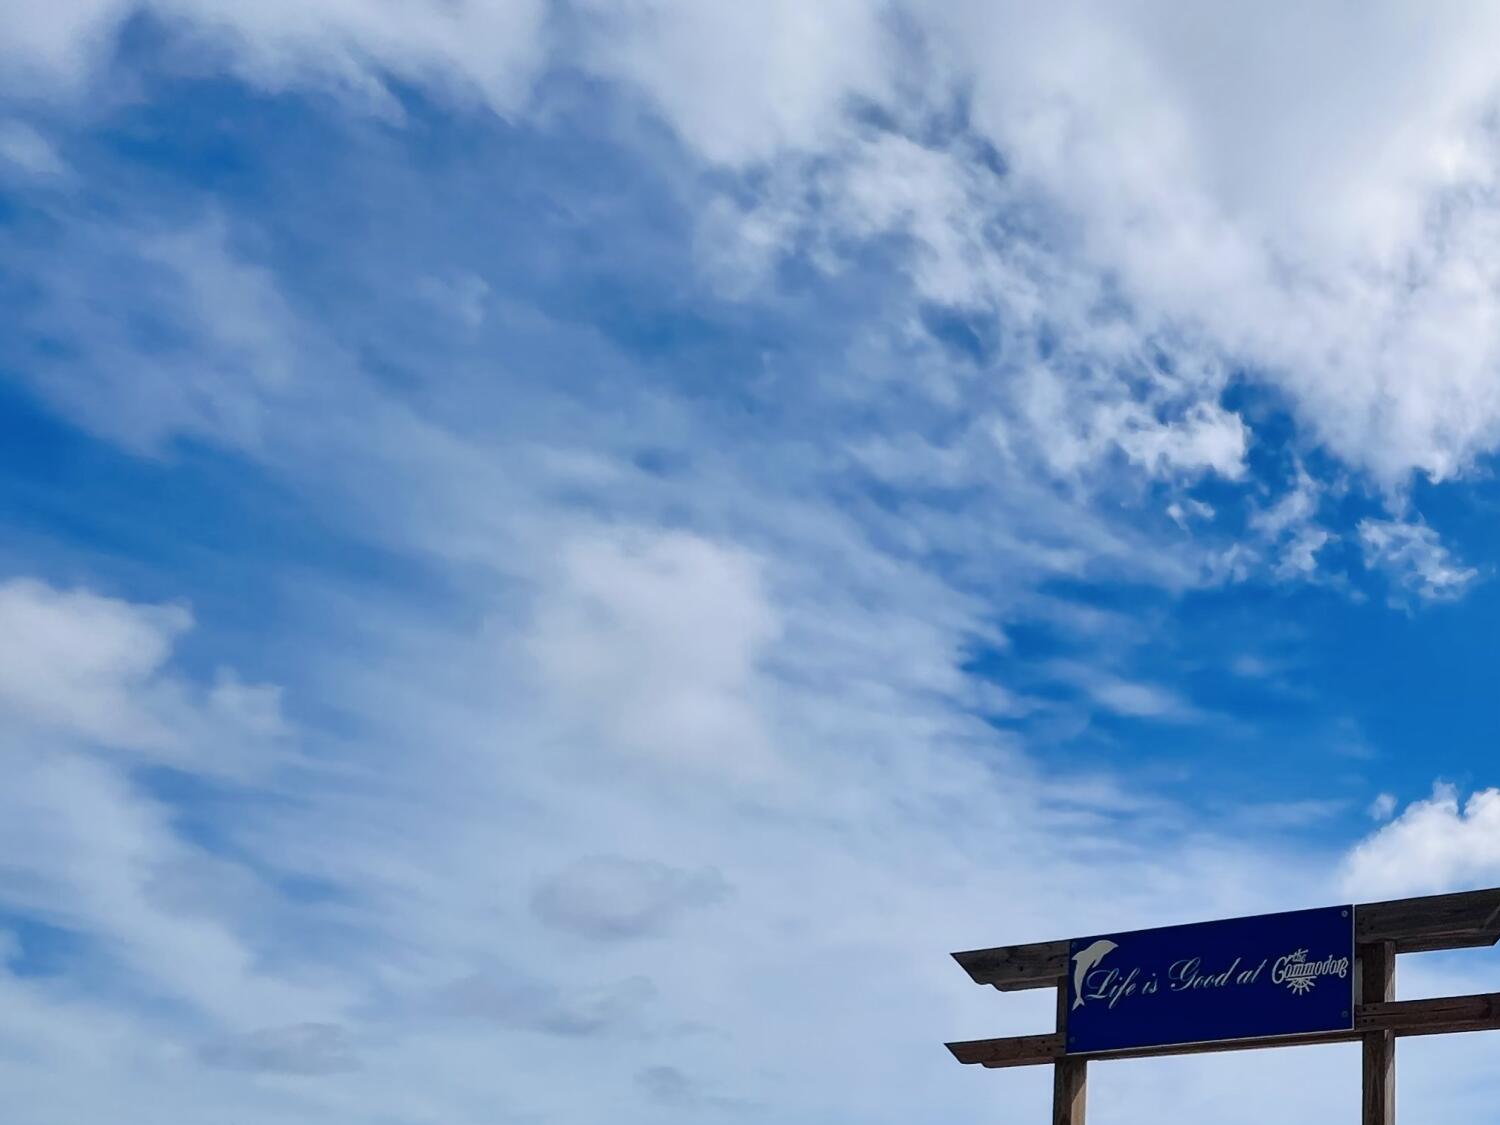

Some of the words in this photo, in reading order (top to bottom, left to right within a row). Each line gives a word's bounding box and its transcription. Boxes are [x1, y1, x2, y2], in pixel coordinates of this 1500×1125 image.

[1272, 954, 1349, 985] Commodore
[1288, 948, 1308, 963] the
[1086, 967, 1139, 1009] Life
[1142, 973, 1158, 995] is
[1168, 957, 1241, 992] Good
[1236, 959, 1267, 985] at
